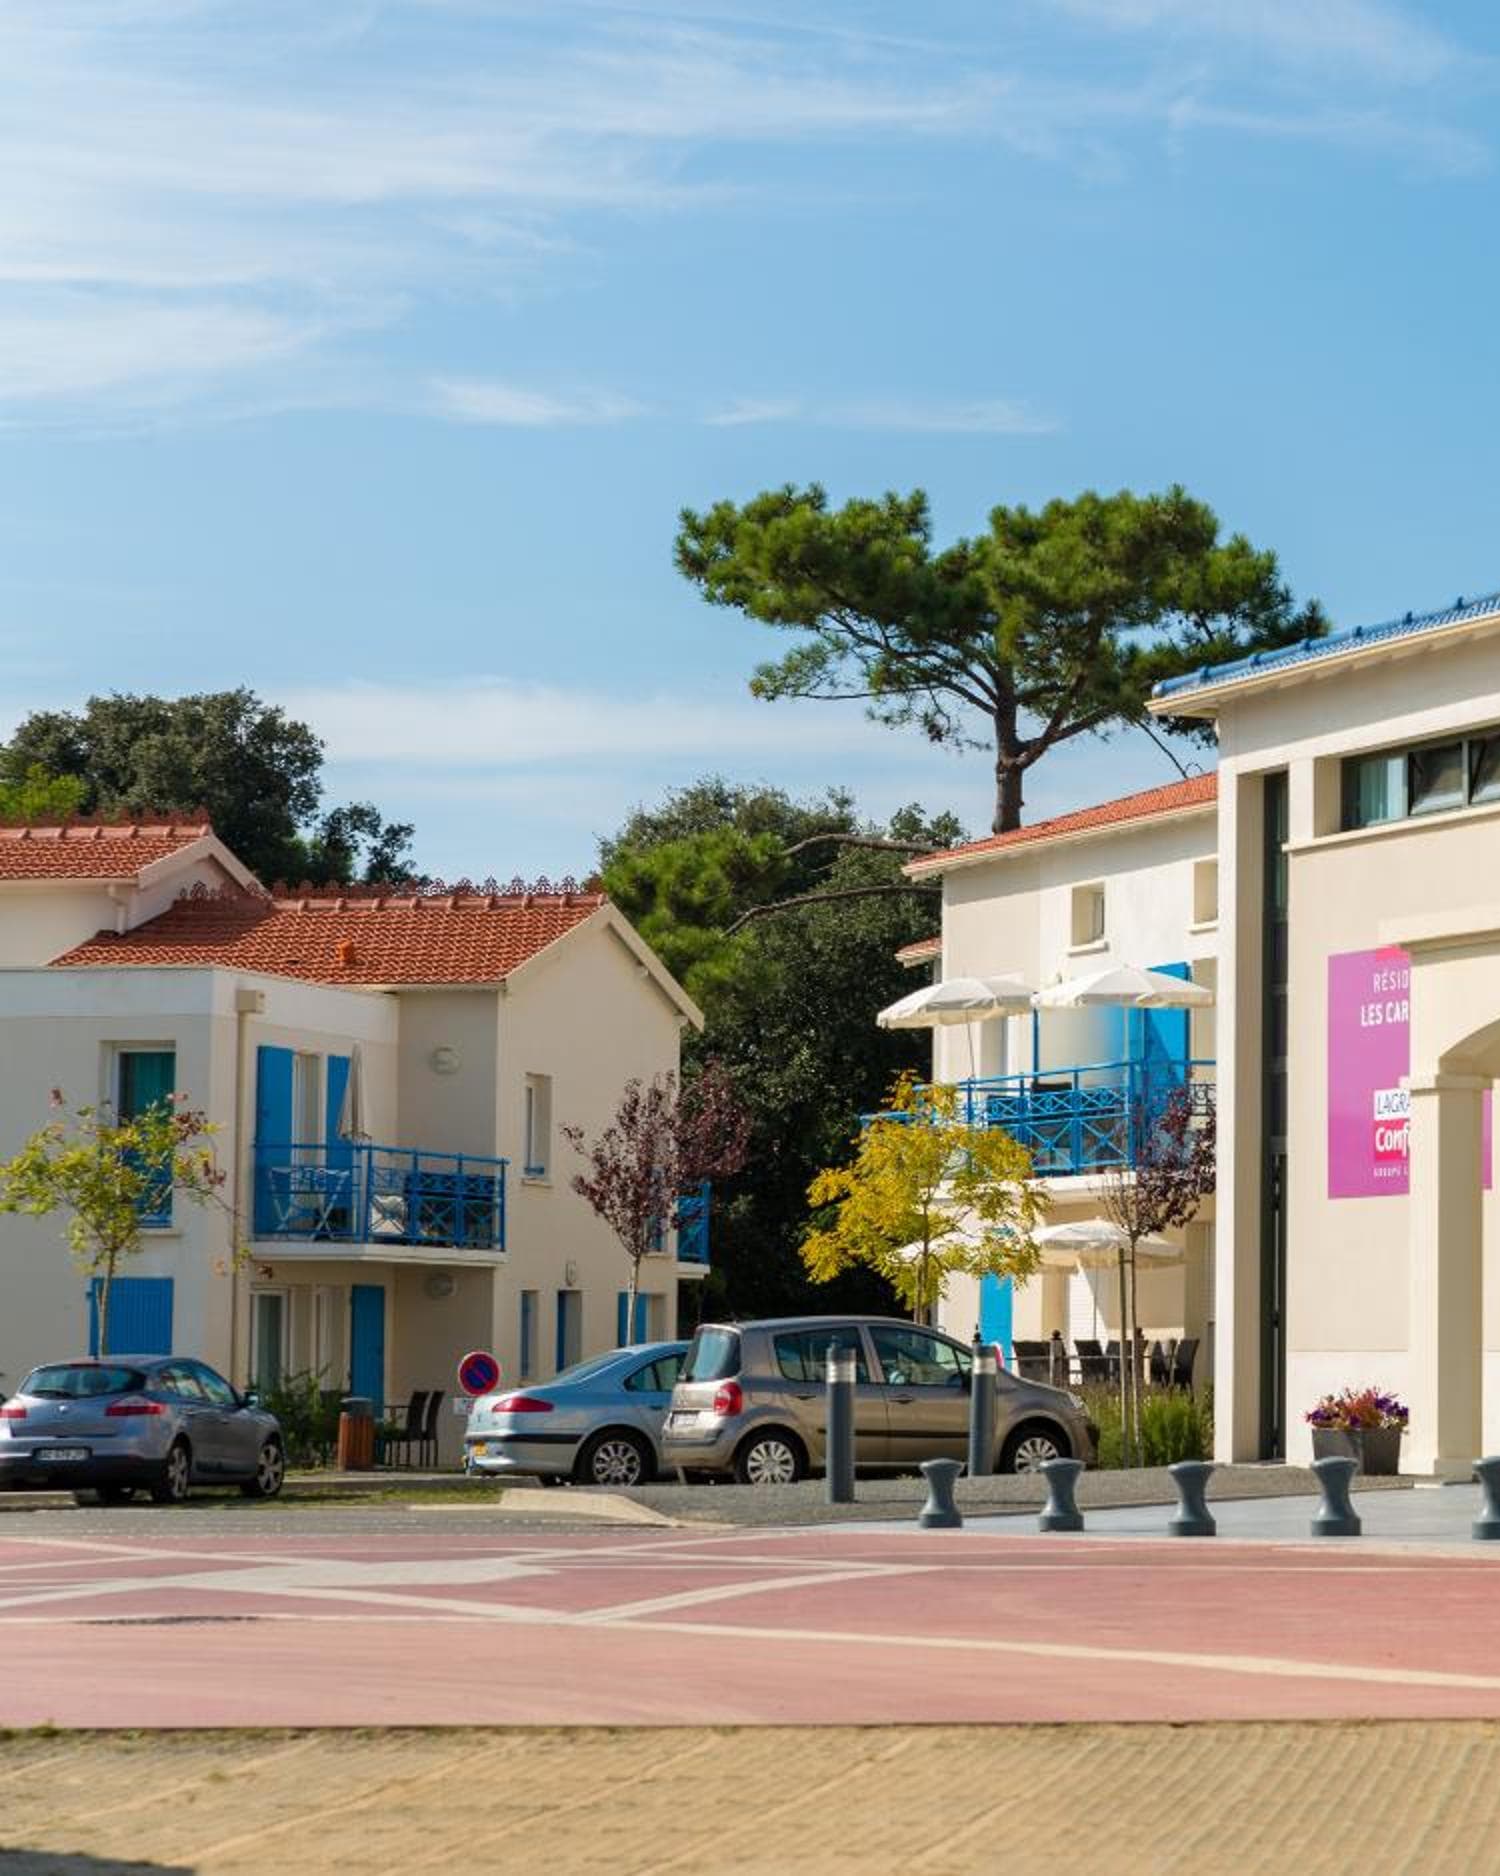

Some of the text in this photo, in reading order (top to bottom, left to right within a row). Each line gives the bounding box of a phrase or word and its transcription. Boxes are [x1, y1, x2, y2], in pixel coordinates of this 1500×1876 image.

[1361, 1003, 1383, 1027] LES
[1377, 1092, 1409, 1115] LAGR
[1375, 1122, 1409, 1158] Conf
